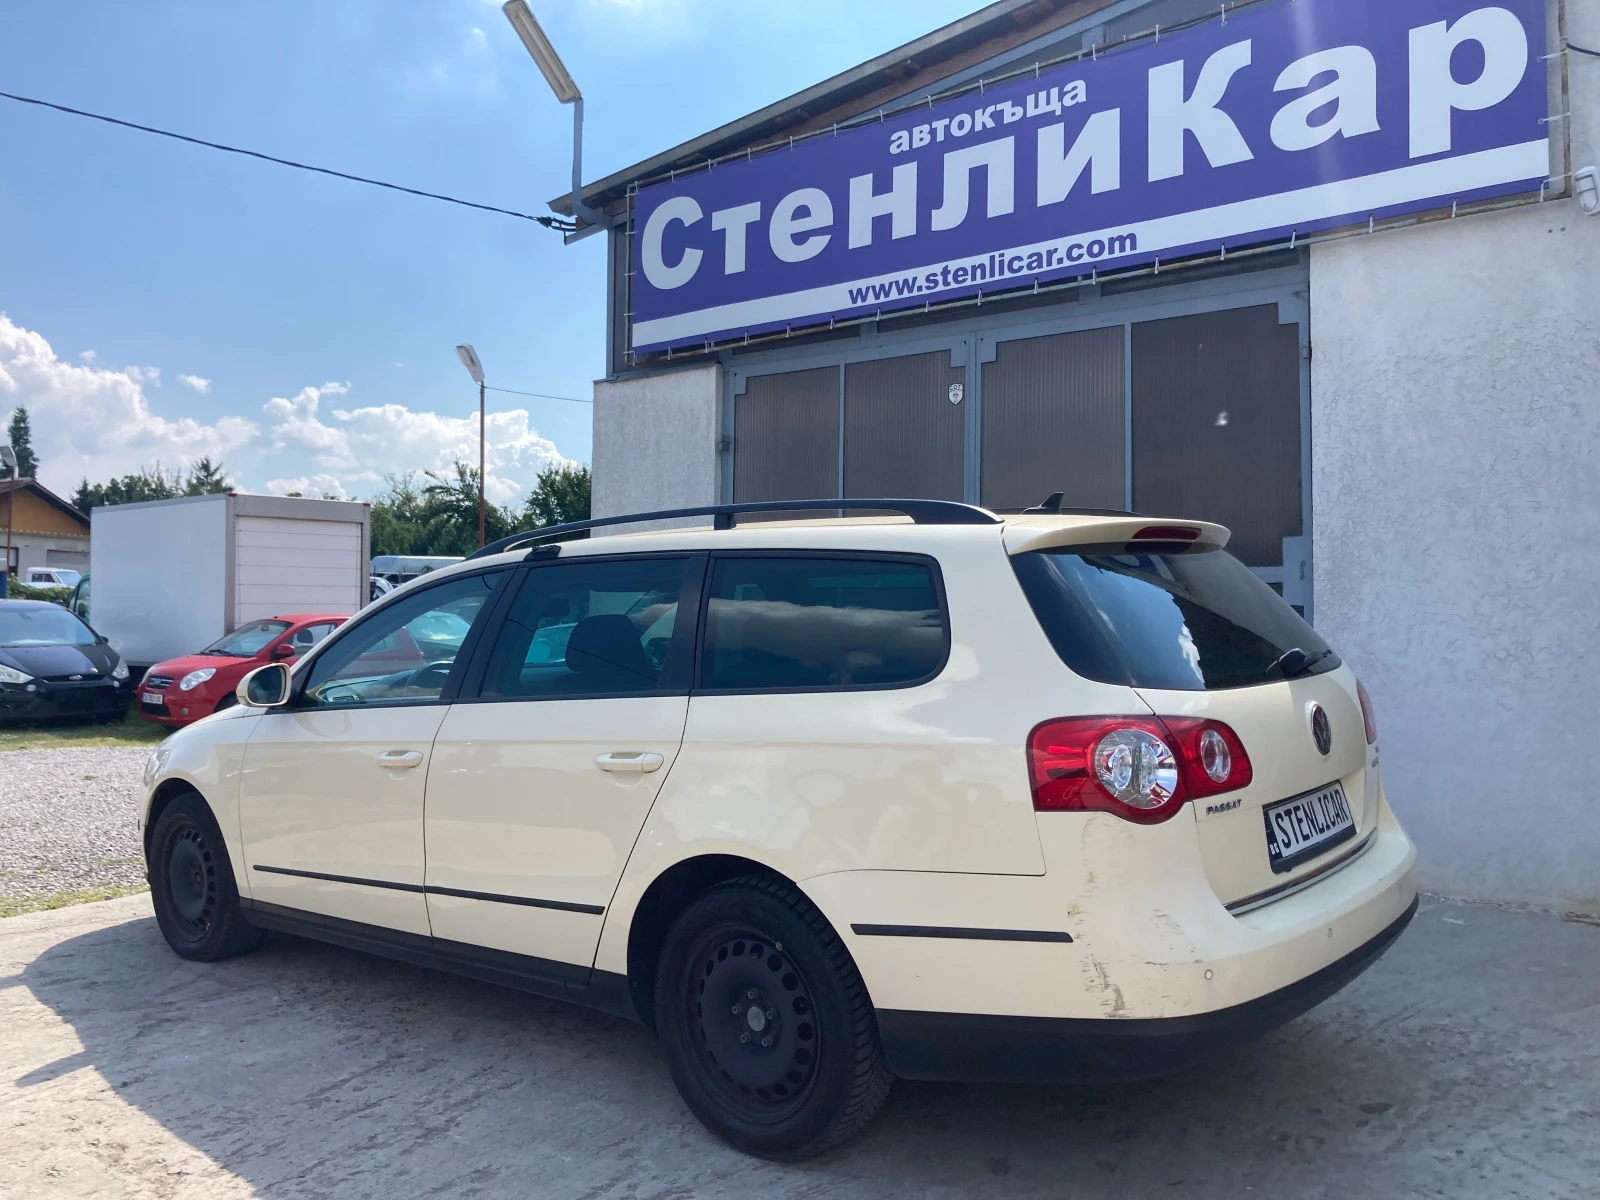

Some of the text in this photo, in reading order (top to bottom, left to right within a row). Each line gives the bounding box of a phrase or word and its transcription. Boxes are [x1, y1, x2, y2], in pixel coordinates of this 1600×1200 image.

[889, 79, 1087, 155] автокъща
[848, 232, 1138, 305] www.stenlicar.com
[1206, 798, 1242, 816] PASSAT
[1274, 788, 1349, 849] STENLICAR
